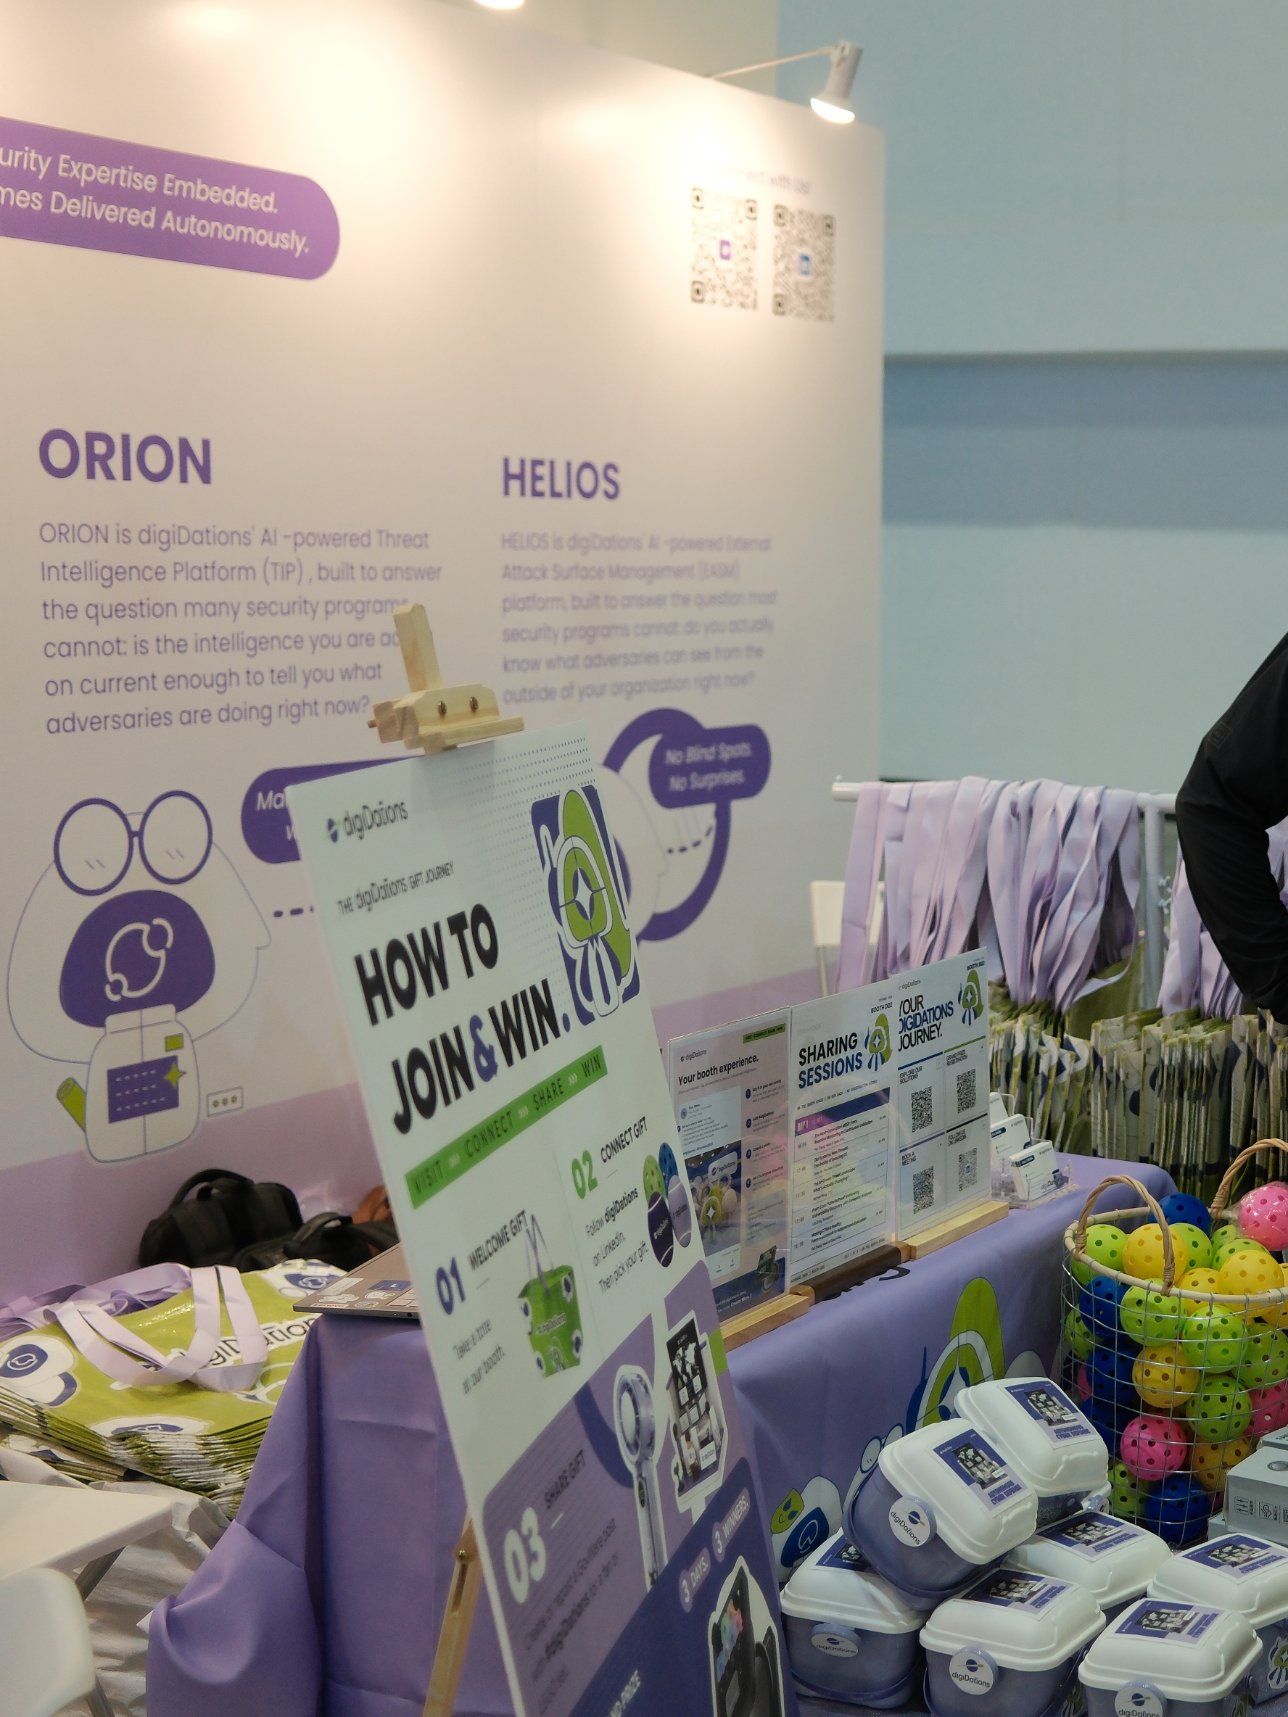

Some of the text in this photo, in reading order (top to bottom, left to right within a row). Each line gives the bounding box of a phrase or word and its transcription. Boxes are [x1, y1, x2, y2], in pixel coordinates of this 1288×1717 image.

[0, 147, 278, 214] urity Expertise Embedded.
[0, 187, 309, 254] mes Delivered Autonomously.
[39, 428, 212, 484] ORION
[503, 457, 620, 500] HELIOS
[40, 522, 109, 544] ORION
[116, 524, 132, 546] is
[138, 524, 255, 551] digiDations'
[261, 528, 277, 547] AI
[376, 529, 429, 549] Threat
[502, 532, 548, 551] HELIOS
[553, 535, 563, 551] is
[41, 561, 441, 588] Intelligence Platform built to answer
[502, 564, 547, 582] Attack
[553, 564, 604, 580] Surface
[608, 564, 694, 585] Management
[42, 598, 409, 626] the question many security program
[572, 592, 600, 611] built
[604, 592, 617, 609] to
[622, 592, 667, 608] answer
[671, 591, 690, 606] the
[694, 591, 744, 610] question
[44, 630, 375, 658] cannot: is the intelligence you are
[503, 624, 559, 645] security
[563, 622, 629, 645] programs
[504, 654, 541, 673] know
[546, 653, 579, 671] what
[584, 649, 660, 669] adversaries
[691, 648, 710, 663] see
[45, 662, 382, 696] on current enough to tell you what
[504, 684, 556, 704] outside
[578, 683, 606, 701] your
[47, 695, 369, 734] adversaries are doing right now?
[666, 749, 683, 765] No
[670, 776, 687, 791] No
[338, 898, 353, 915] THE
[354, 903, 499, 1026] HOW TO
[799, 1032, 858, 1066] SHARING
[898, 1022, 942, 1052] JOURNEY.
[678, 1073, 695, 1086] Your
[697, 1066, 718, 1080] booth
[719, 1054, 759, 1074] experience.
[798, 1052, 863, 1089] SESSIONS
[414, 1057, 601, 1194] VISIT CONNECT SHARE WIN
[600, 1129, 633, 1163] CONNECT
[633, 1116, 648, 1138] GIFT
[572, 1150, 598, 1200] 02
[604, 1187, 638, 1223] digiDations
[469, 1209, 528, 1271] WELCOME GIFT
[436, 1256, 466, 1315] 01
[599, 1275, 614, 1294] Then
[504, 1506, 546, 1604] 03
[715, 1531, 722, 1553] 3
[682, 1579, 690, 1603] 3
[952, 1672, 990, 1688] digiDations
